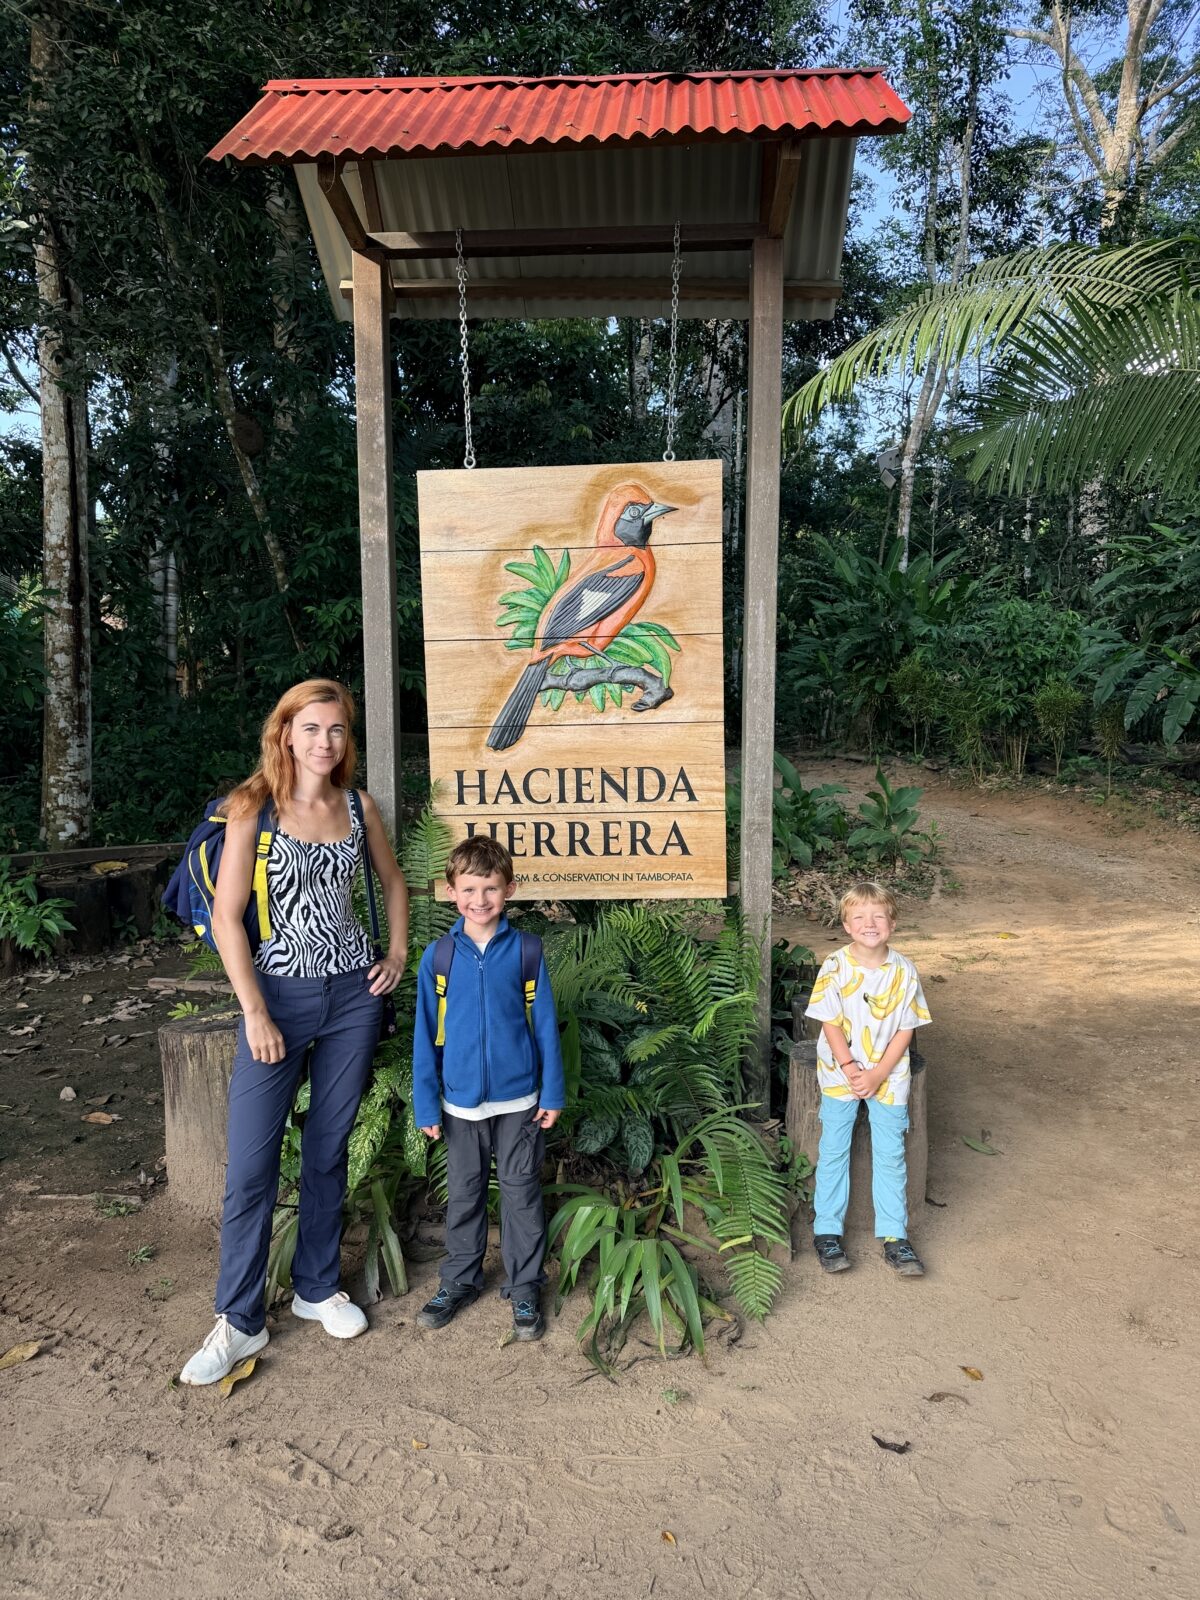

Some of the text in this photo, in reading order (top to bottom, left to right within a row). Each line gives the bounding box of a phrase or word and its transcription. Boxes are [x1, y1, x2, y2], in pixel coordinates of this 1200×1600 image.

[455, 766, 699, 806] HACIENDA
[532, 873, 541, 883] &
[542, 872, 620, 882] CONSERVATION
[622, 872, 634, 881] IN
[636, 872, 694, 881] TAMBOPATA
